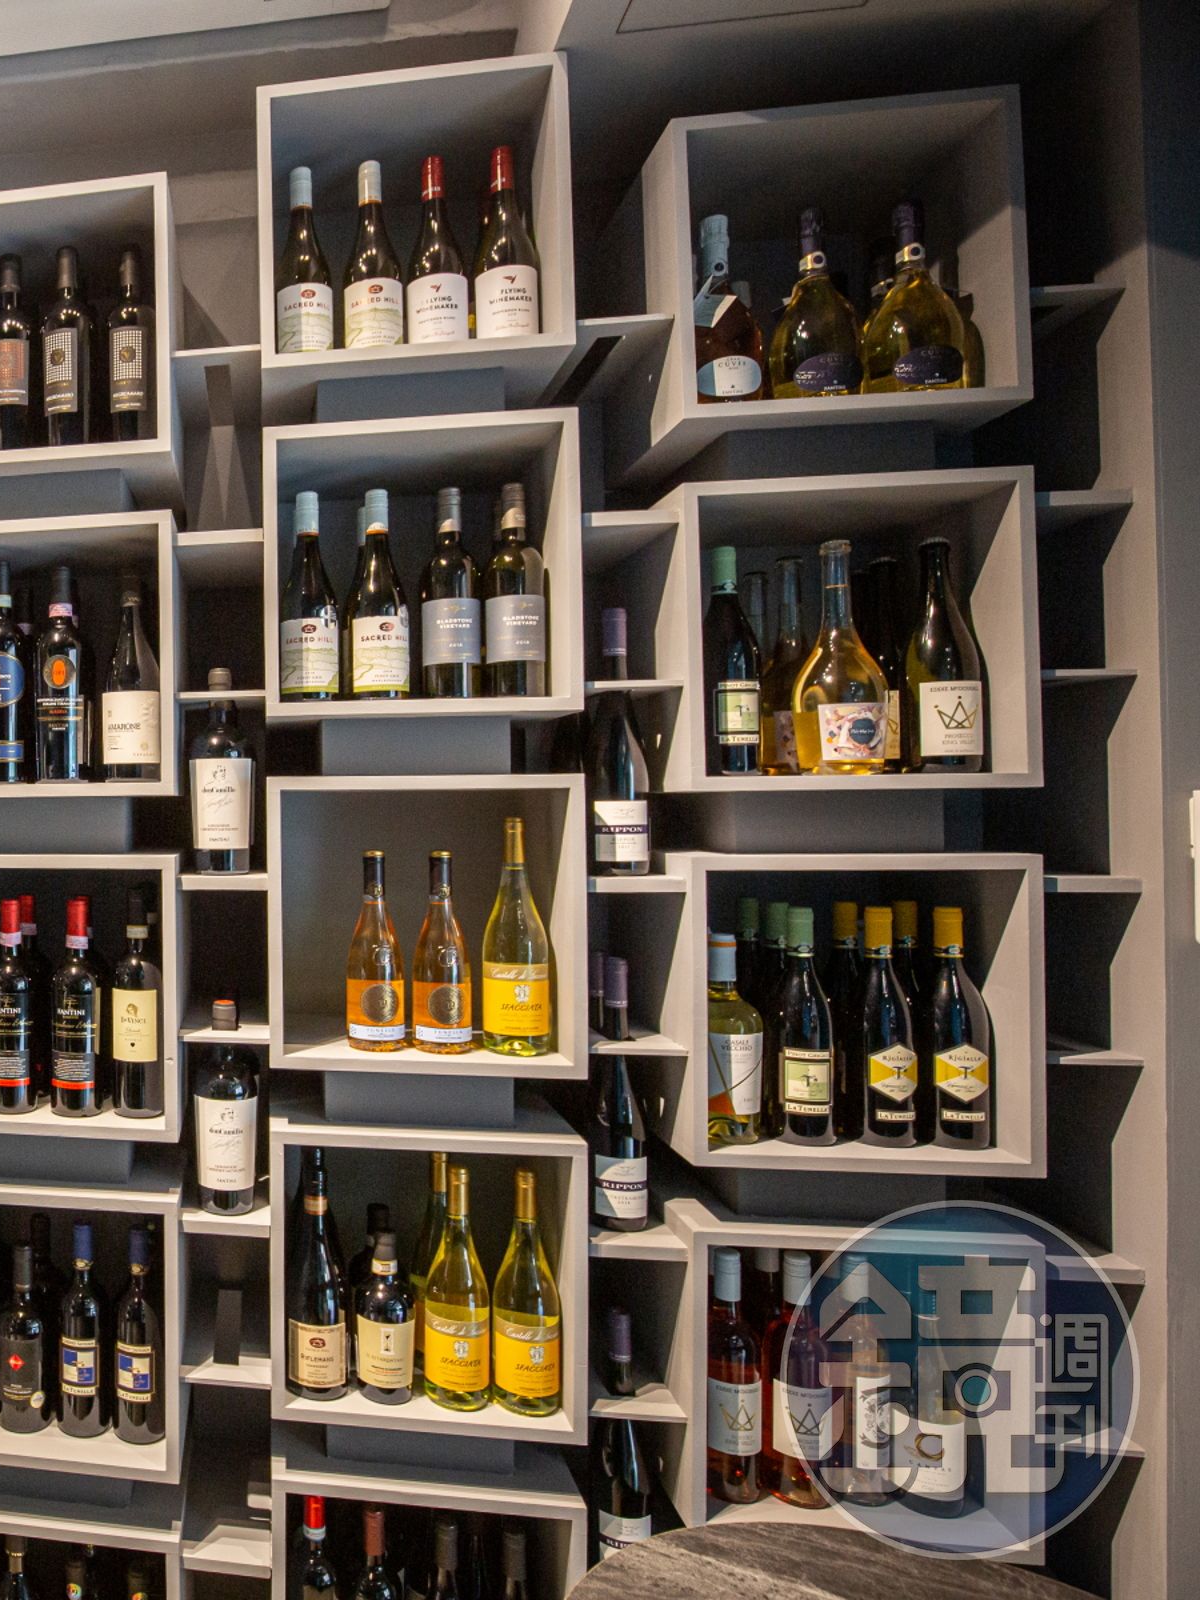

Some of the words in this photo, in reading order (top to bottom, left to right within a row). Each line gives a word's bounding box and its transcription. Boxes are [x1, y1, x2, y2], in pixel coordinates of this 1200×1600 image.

[284, 301, 314, 312] SACRED
[285, 636, 315, 645] SACRED
[361, 634, 393, 643] SACRED
[601, 1182, 642, 1190] RIPPON
